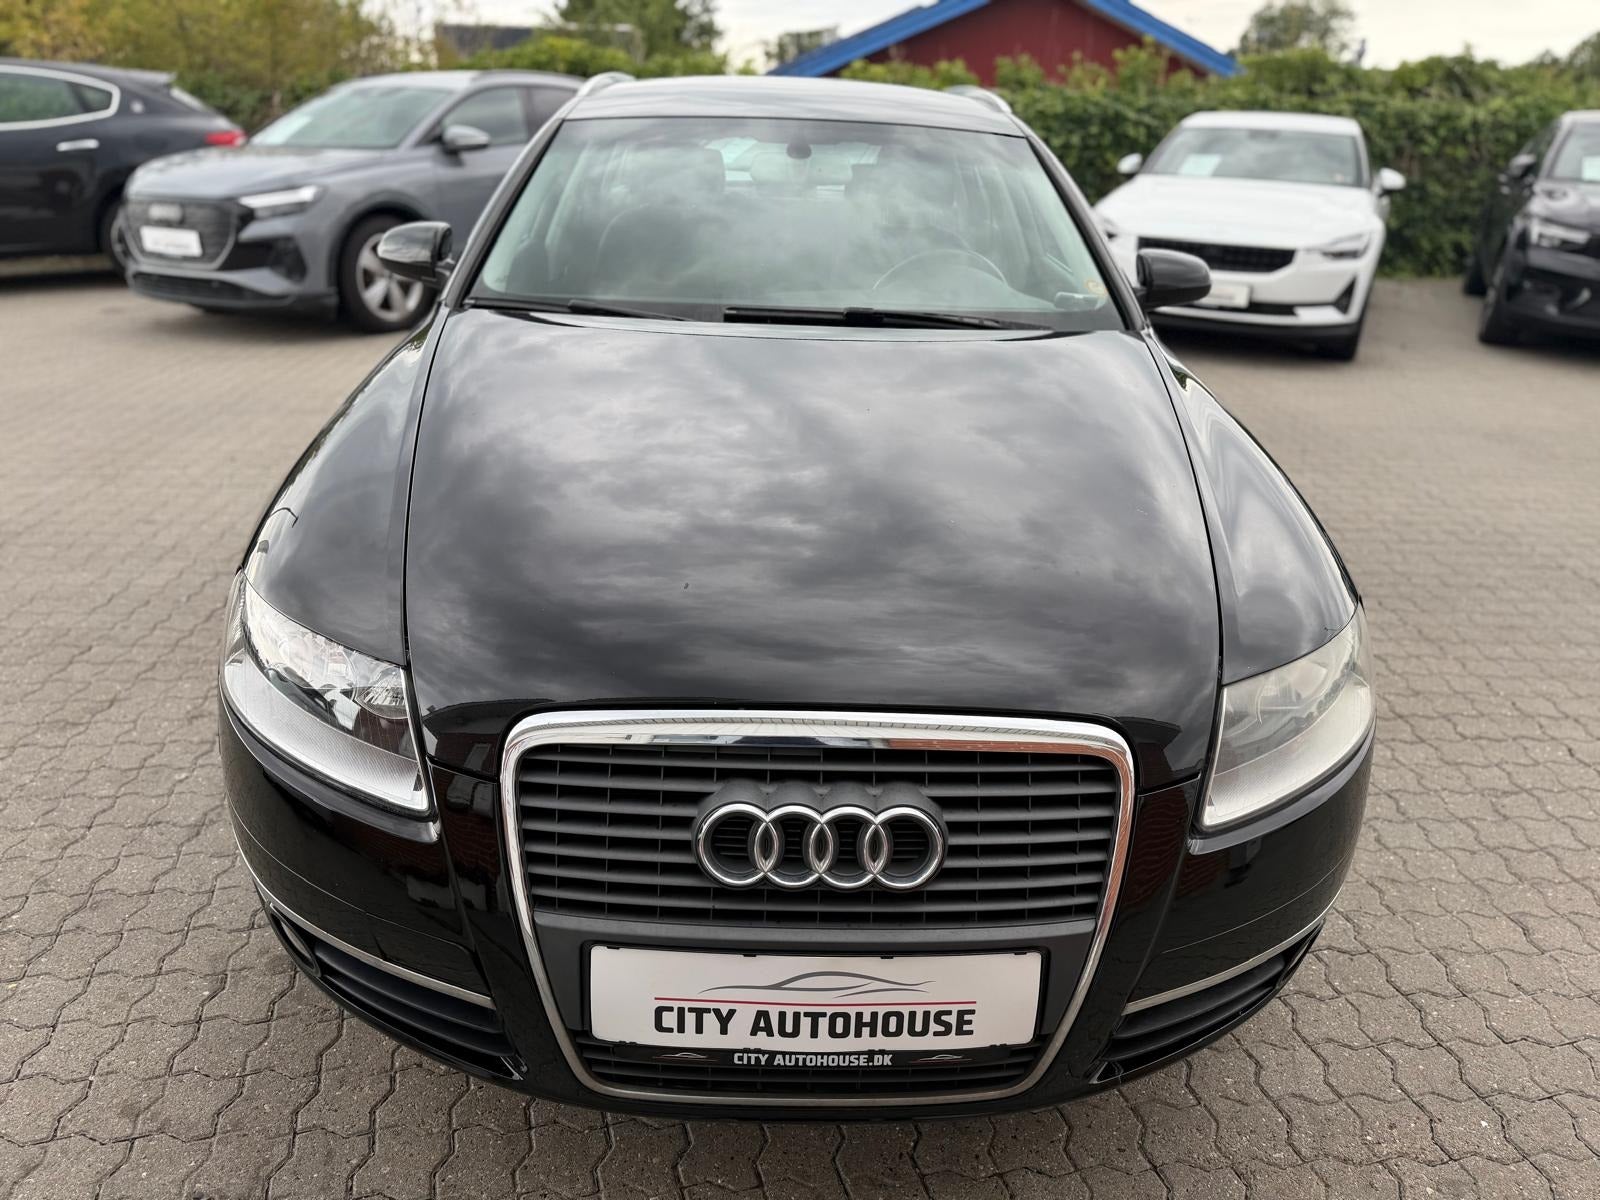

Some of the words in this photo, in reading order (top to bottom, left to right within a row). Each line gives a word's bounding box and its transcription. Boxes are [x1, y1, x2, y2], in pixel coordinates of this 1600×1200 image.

[654, 1005, 737, 1036] CITY
[750, 1008, 976, 1039] AUTOHOUSE
[733, 1052, 770, 1065] CITY
[773, 1053, 893, 1067] AUTOHOUSE.DK
